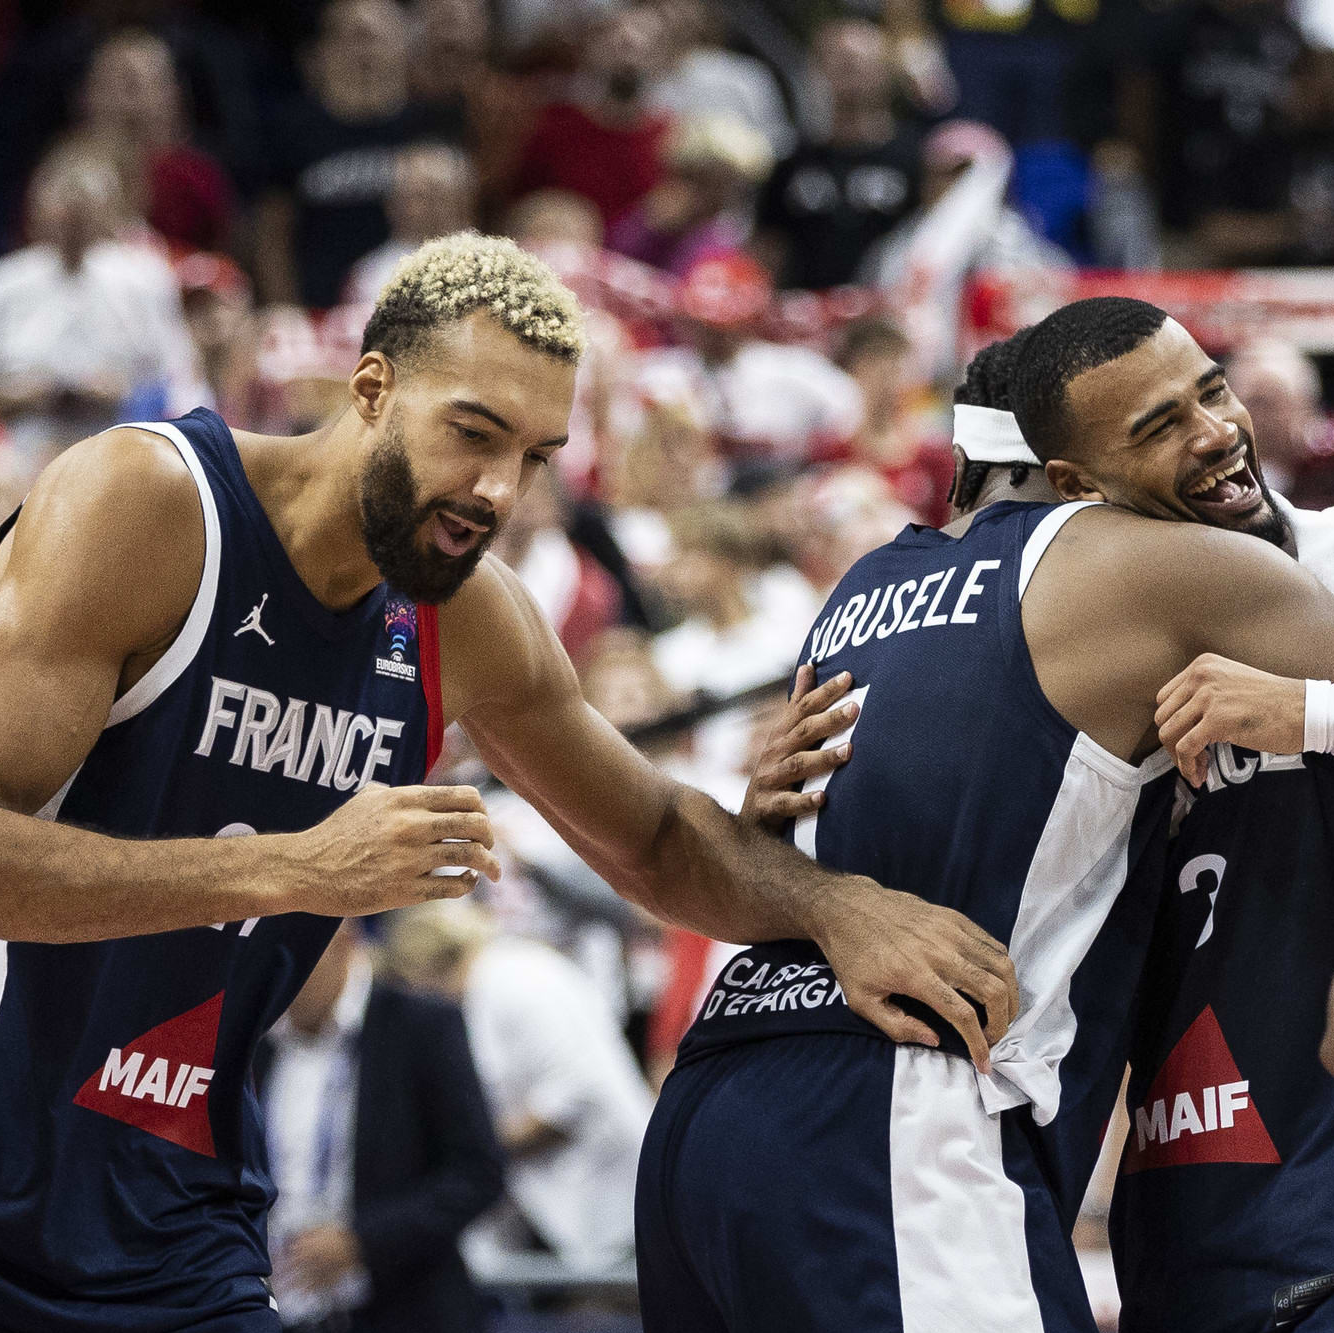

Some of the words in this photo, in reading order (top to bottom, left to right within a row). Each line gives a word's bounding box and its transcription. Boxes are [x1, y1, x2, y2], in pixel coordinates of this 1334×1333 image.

[193, 675, 406, 793] FRANCE
[98, 1047, 216, 1109] MAIF
[1135, 1079, 1250, 1153] MAIF
